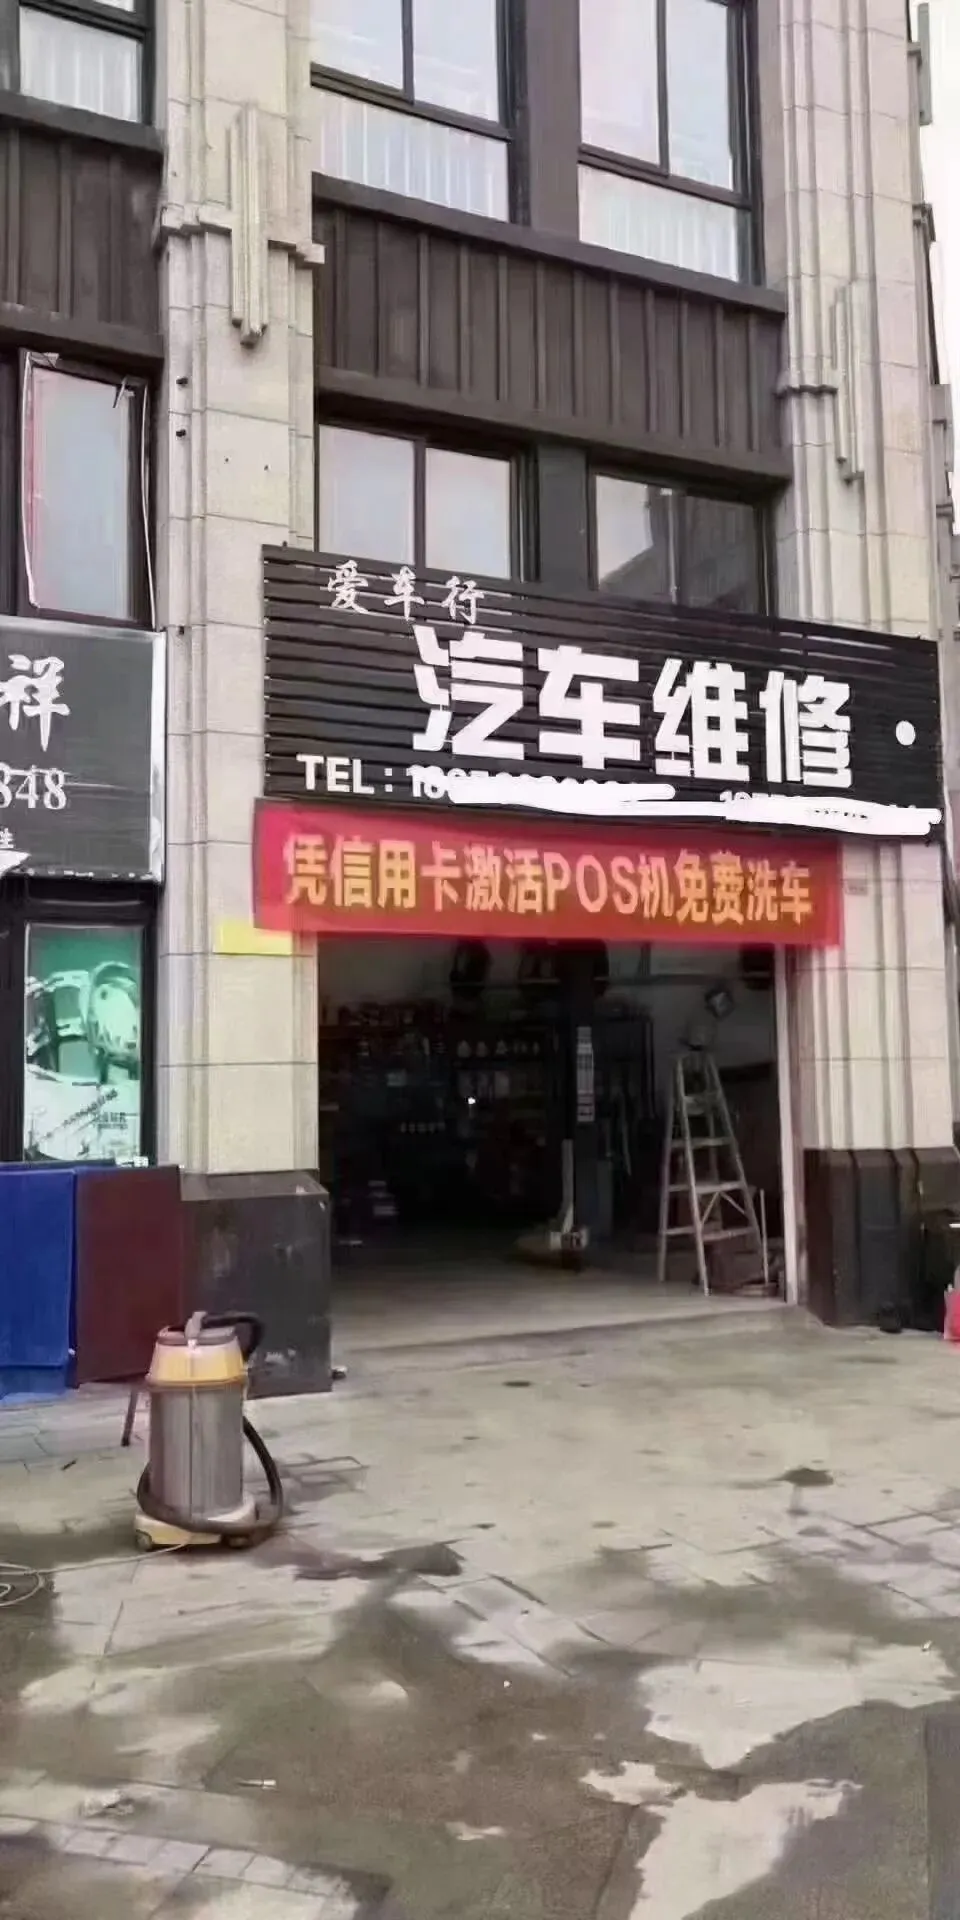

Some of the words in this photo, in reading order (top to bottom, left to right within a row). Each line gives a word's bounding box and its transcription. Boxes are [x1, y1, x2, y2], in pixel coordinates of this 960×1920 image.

[0, 654, 71, 752] 祥
[412, 623, 852, 788] 汽车维修
[283, 833, 814, 926] 凭信用卡激活POS机免费洗车
